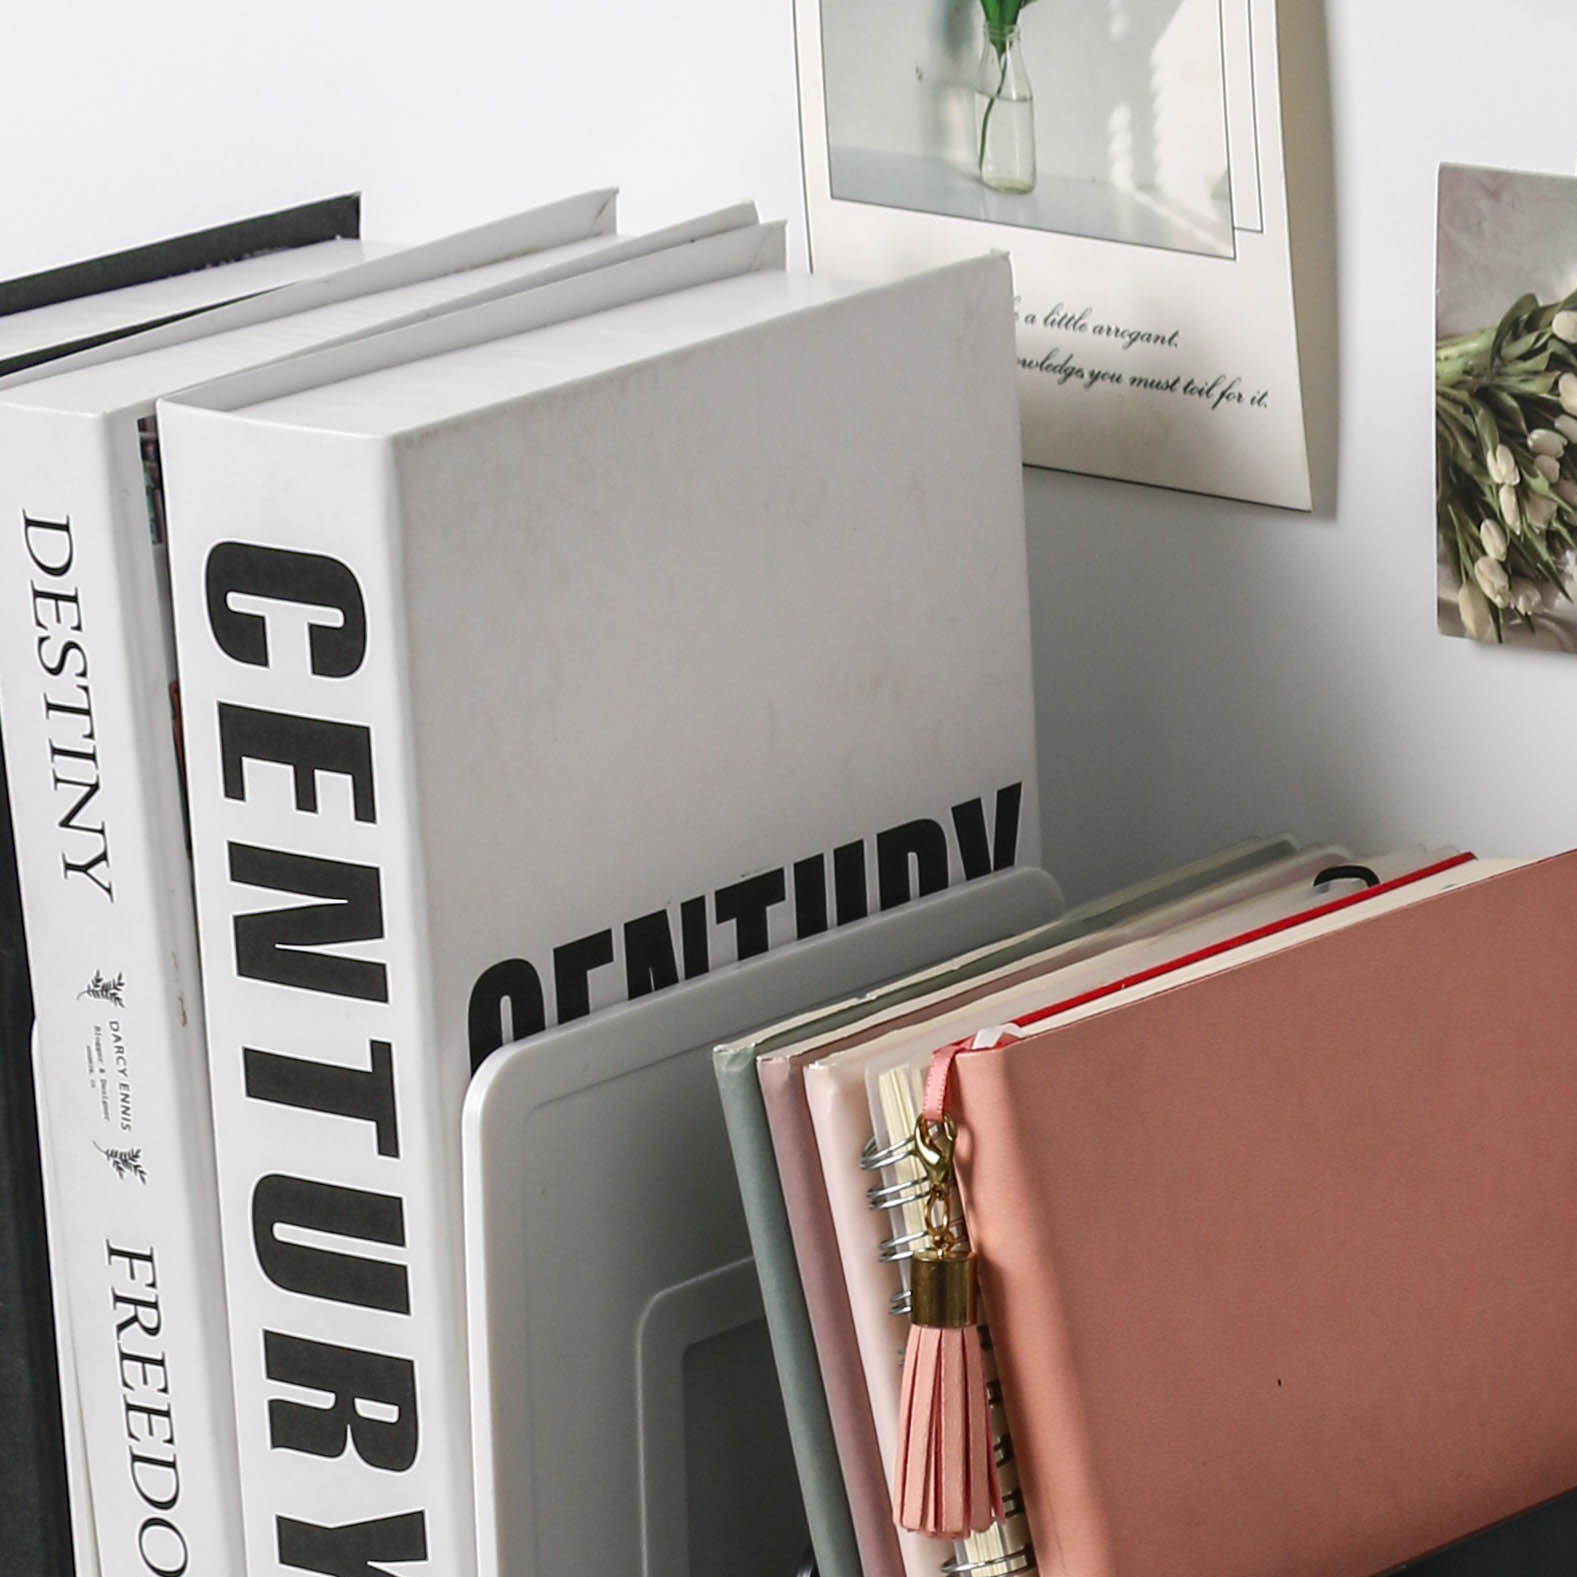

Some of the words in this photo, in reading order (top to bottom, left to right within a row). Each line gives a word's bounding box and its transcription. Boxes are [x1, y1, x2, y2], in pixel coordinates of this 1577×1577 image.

[1043, 302, 1090, 334] little
[1083, 368, 1124, 389] you
[1128, 375, 1183, 394] must
[1210, 377, 1244, 411] for
[22, 508, 114, 903] DESTINY
[109, 1020, 128, 1077] DARCY
[119, 1082, 132, 1132] ENNIS
